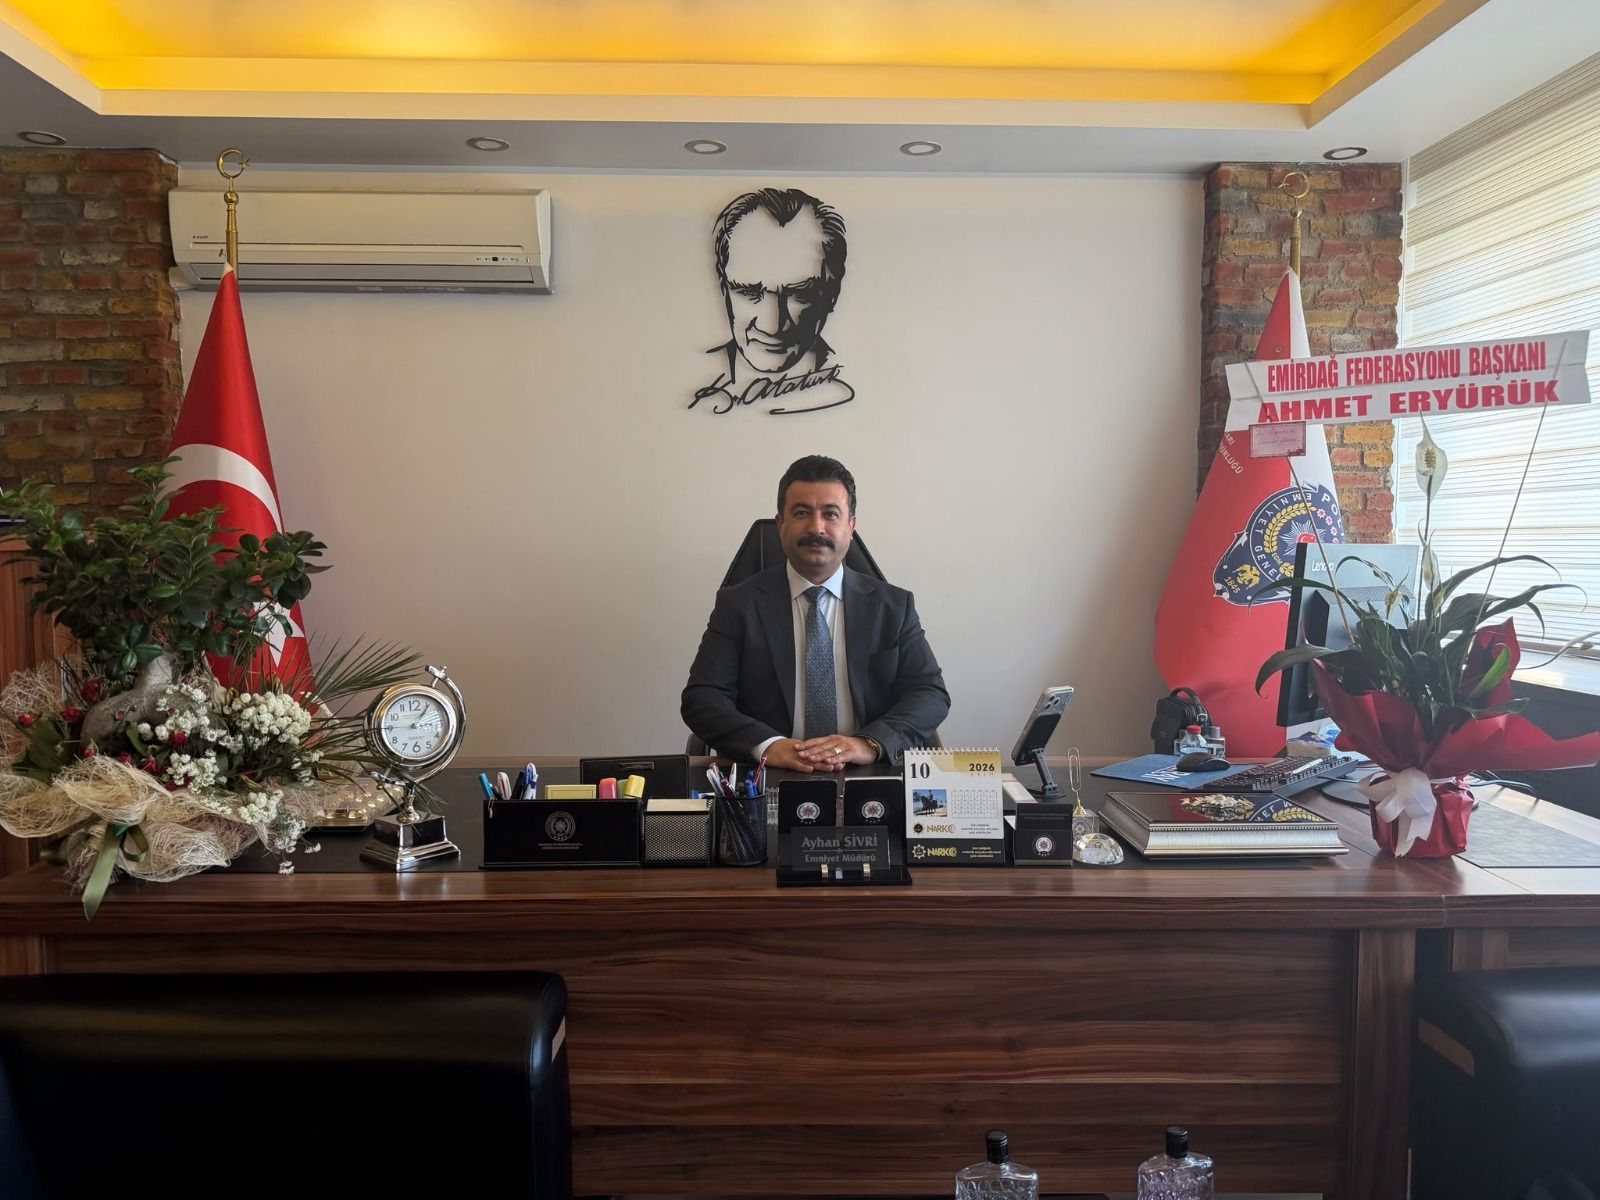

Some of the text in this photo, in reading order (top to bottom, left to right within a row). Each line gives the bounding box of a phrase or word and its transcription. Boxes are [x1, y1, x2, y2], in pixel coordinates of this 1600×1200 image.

[1268, 341, 1547, 392] EMİRDAĞ FEDERASYONU BAŞKANI
[1258, 379, 1560, 423] AHMET ERYÜRÜK
[409, 700, 421, 712] 12
[390, 713, 399, 721] 10
[392, 736, 398, 744] 8
[426, 741, 432, 749] 5
[402, 743, 408, 751] 7
[412, 741, 421, 753] 6
[910, 762, 995, 779] 10 2026
[801, 833, 878, 850] Ayhan SİVRİ
[805, 853, 876, 863] Emniyet Müdürü
